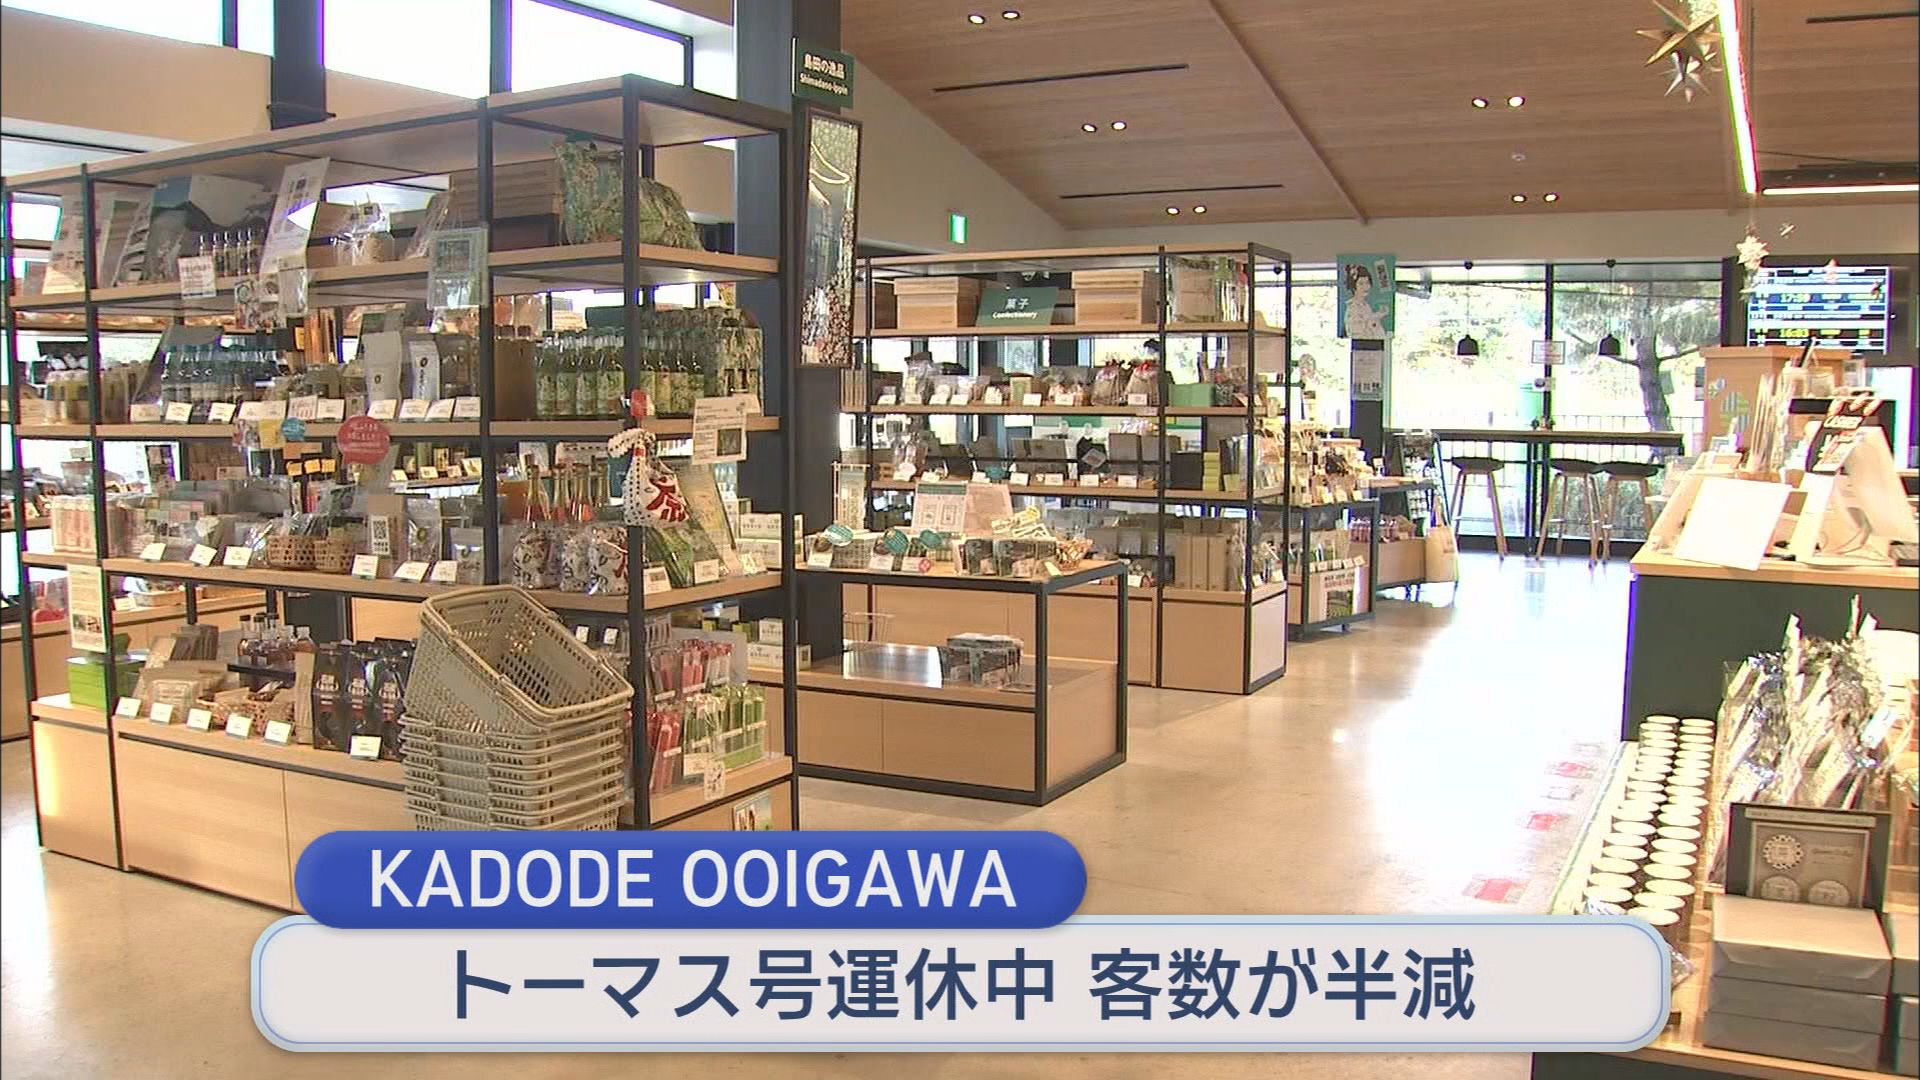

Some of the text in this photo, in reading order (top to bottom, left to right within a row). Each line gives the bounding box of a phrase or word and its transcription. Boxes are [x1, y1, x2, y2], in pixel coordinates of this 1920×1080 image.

[804, 53, 845, 80] 島田の逸品
[1004, 298, 1029, 310] 菓子
[992, 311, 1038, 320] Confectionery
